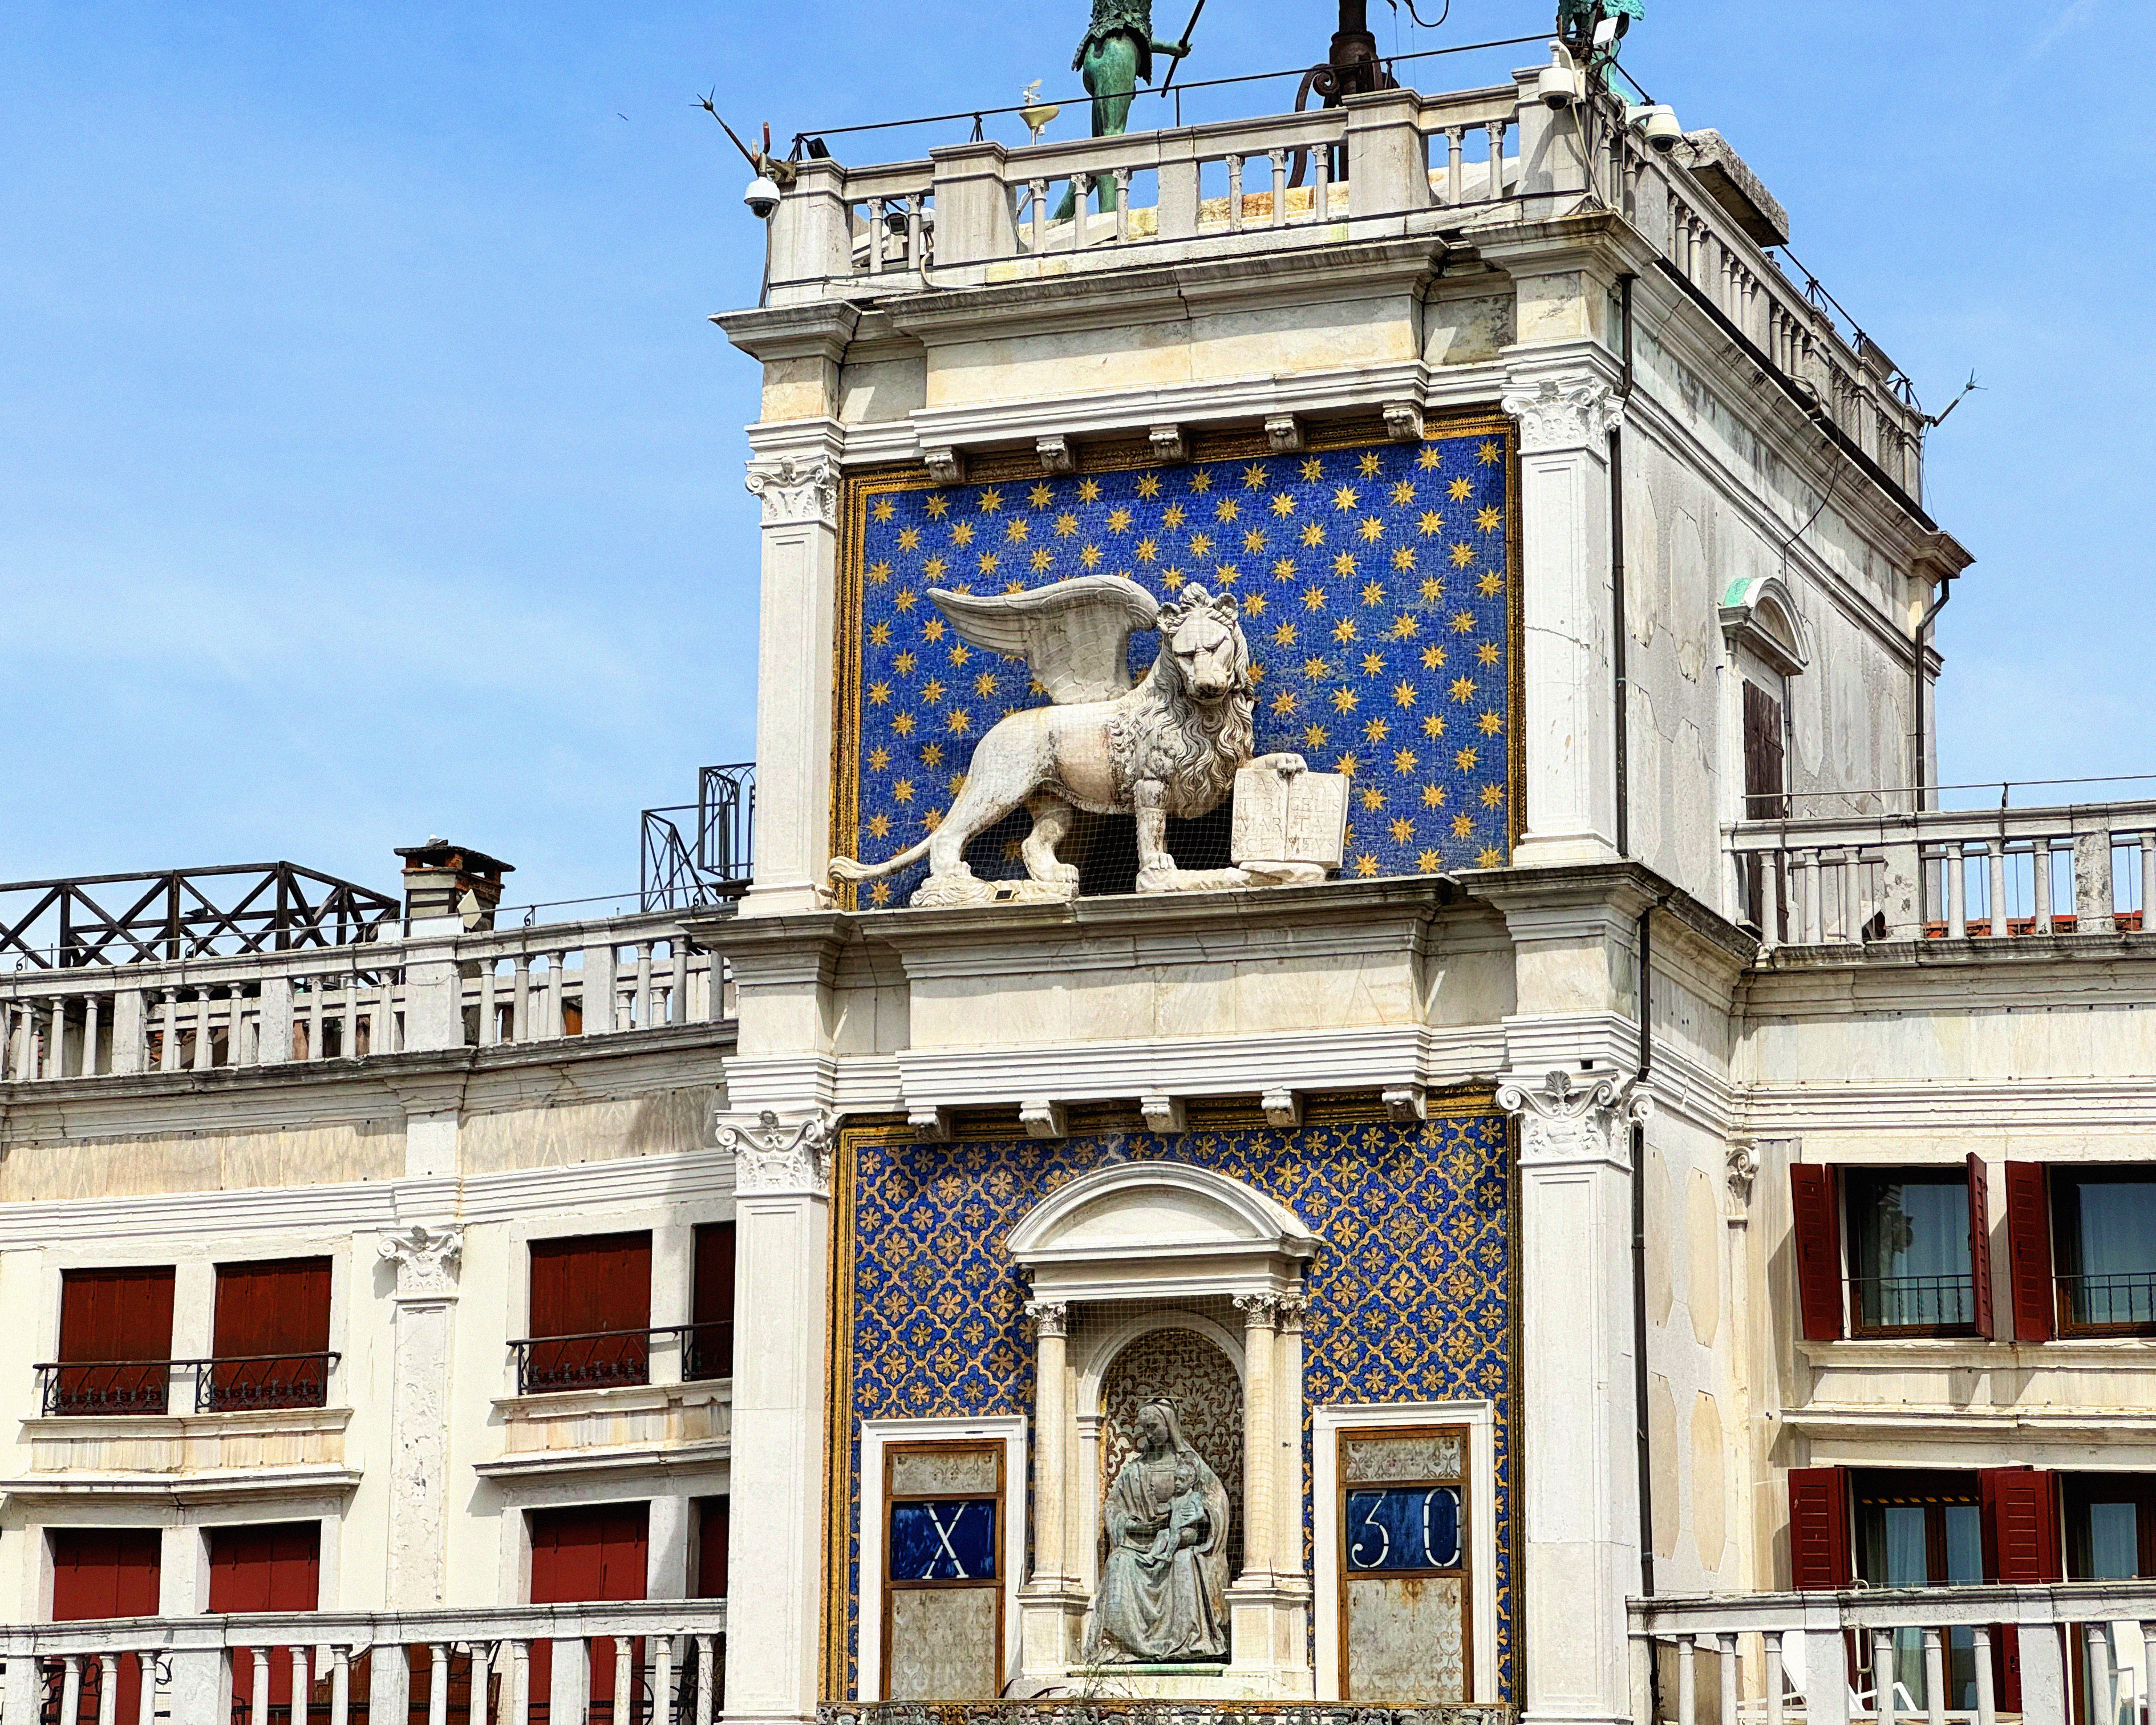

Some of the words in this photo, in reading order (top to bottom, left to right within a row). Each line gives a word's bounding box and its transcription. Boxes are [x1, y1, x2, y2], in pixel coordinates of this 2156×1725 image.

[1242, 776, 1283, 792] PAX
[1238, 796, 1281, 812] TIBI
[1239, 817, 1283, 833] MAR
[1294, 816, 1323, 832] TA
[1246, 837, 1272, 853] CE
[1351, 1487, 1461, 1568] 30
[922, 1501, 969, 1579] X
